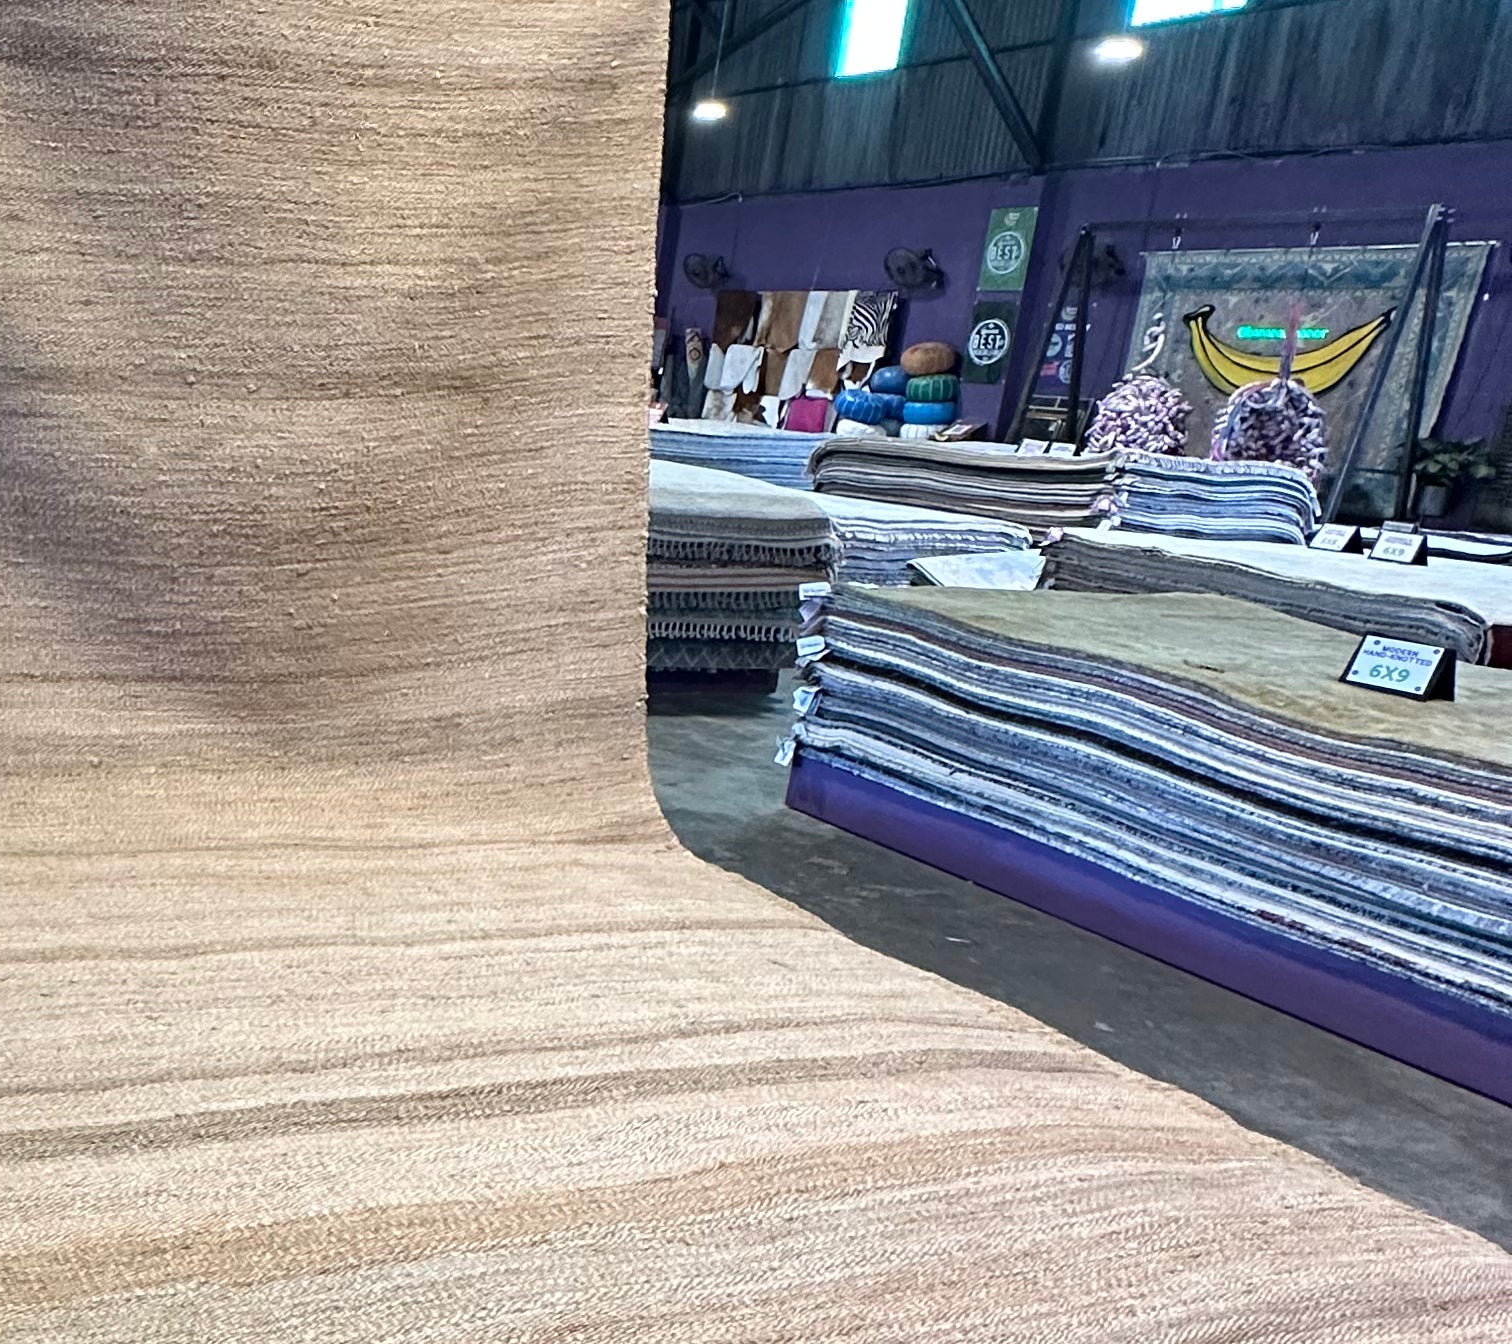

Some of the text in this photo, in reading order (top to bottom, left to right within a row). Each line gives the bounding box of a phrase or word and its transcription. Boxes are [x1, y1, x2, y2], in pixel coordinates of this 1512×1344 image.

[990, 246, 1018, 260] BEST
[972, 334, 1002, 349] BEST
[1382, 546, 1406, 557] 6X9
[1369, 664, 1411, 683] 6X9
